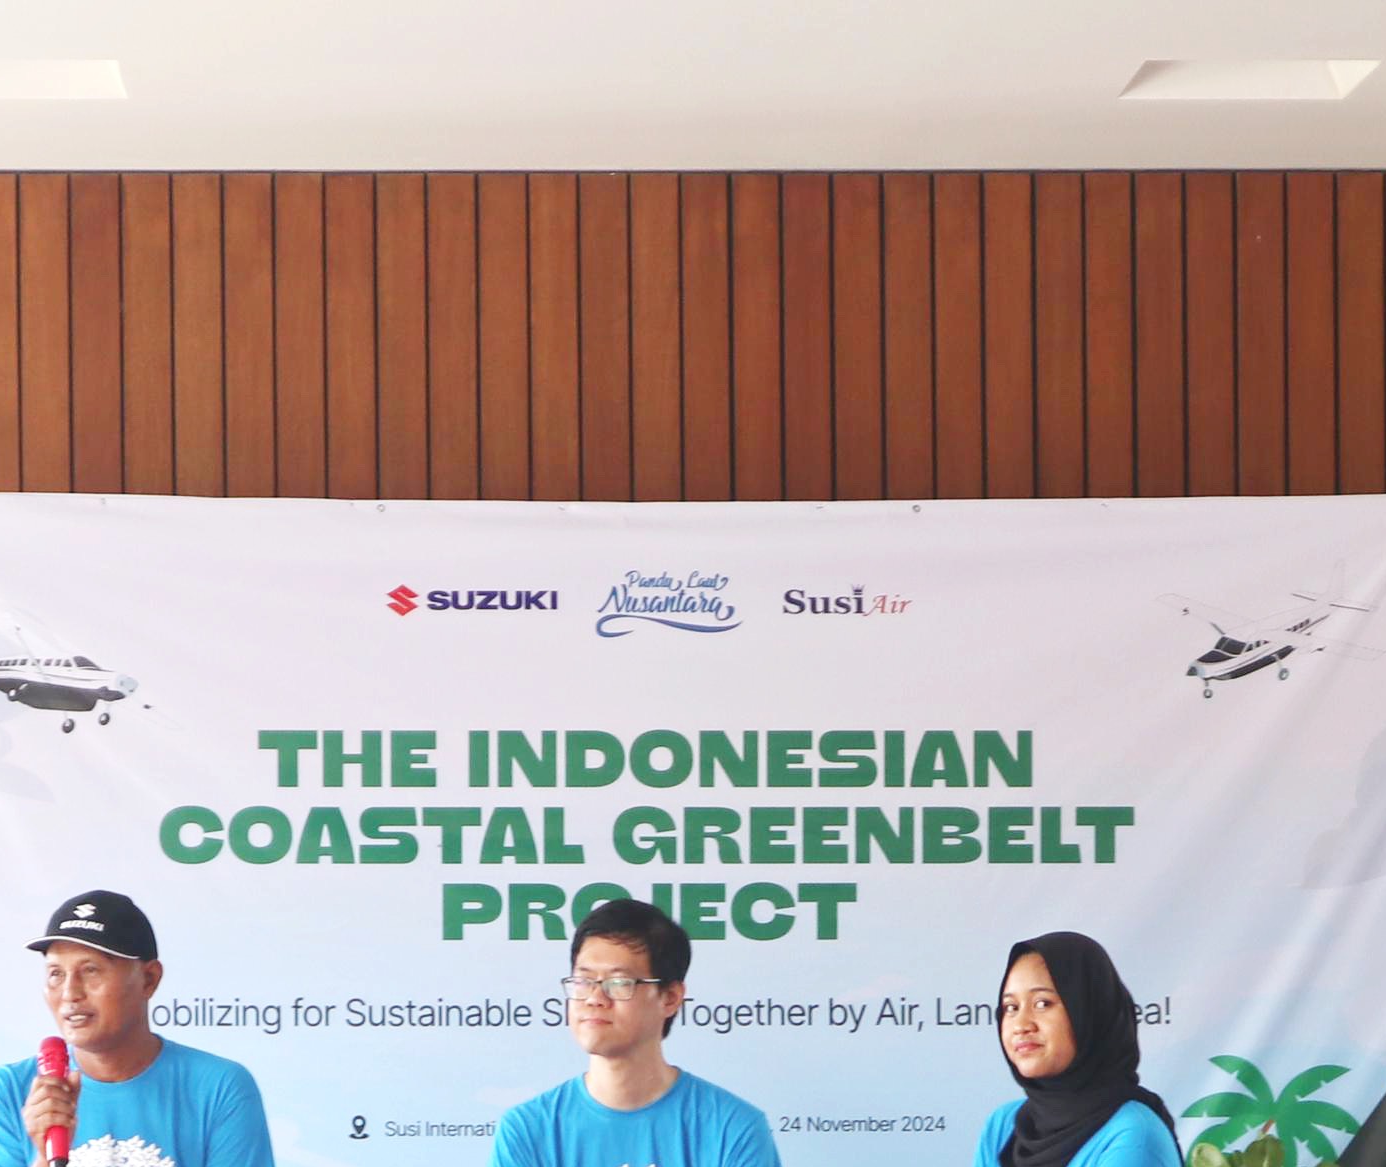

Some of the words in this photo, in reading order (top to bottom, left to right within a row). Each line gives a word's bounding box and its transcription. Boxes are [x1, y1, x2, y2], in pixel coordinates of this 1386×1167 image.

[427, 590, 558, 612] SUZUKI
[597, 583, 736, 621] Nusantara
[782, 587, 864, 614] Susi
[863, 594, 912, 616] Air
[258, 729, 437, 788] THE
[468, 729, 1034, 788] INDONESIAN
[158, 805, 584, 865] COASTAL
[611, 805, 1135, 865] GREENBELT
[59, 919, 105, 931] SUZUKI
[152, 997, 281, 1034] obilizing
[291, 997, 336, 1028] for
[345, 997, 532, 1028] Sustainable
[679, 997, 823, 1034] Together
[828, 997, 866, 1033] by
[876, 998, 924, 1031] Air,
[936, 998, 999, 1026] Lan
[384, 1120, 421, 1137] Susi
[425, 1120, 497, 1137] Internati
[779, 1115, 802, 1132] 24
[806, 1115, 897, 1132] November
[900, 1115, 947, 1132] 2024
